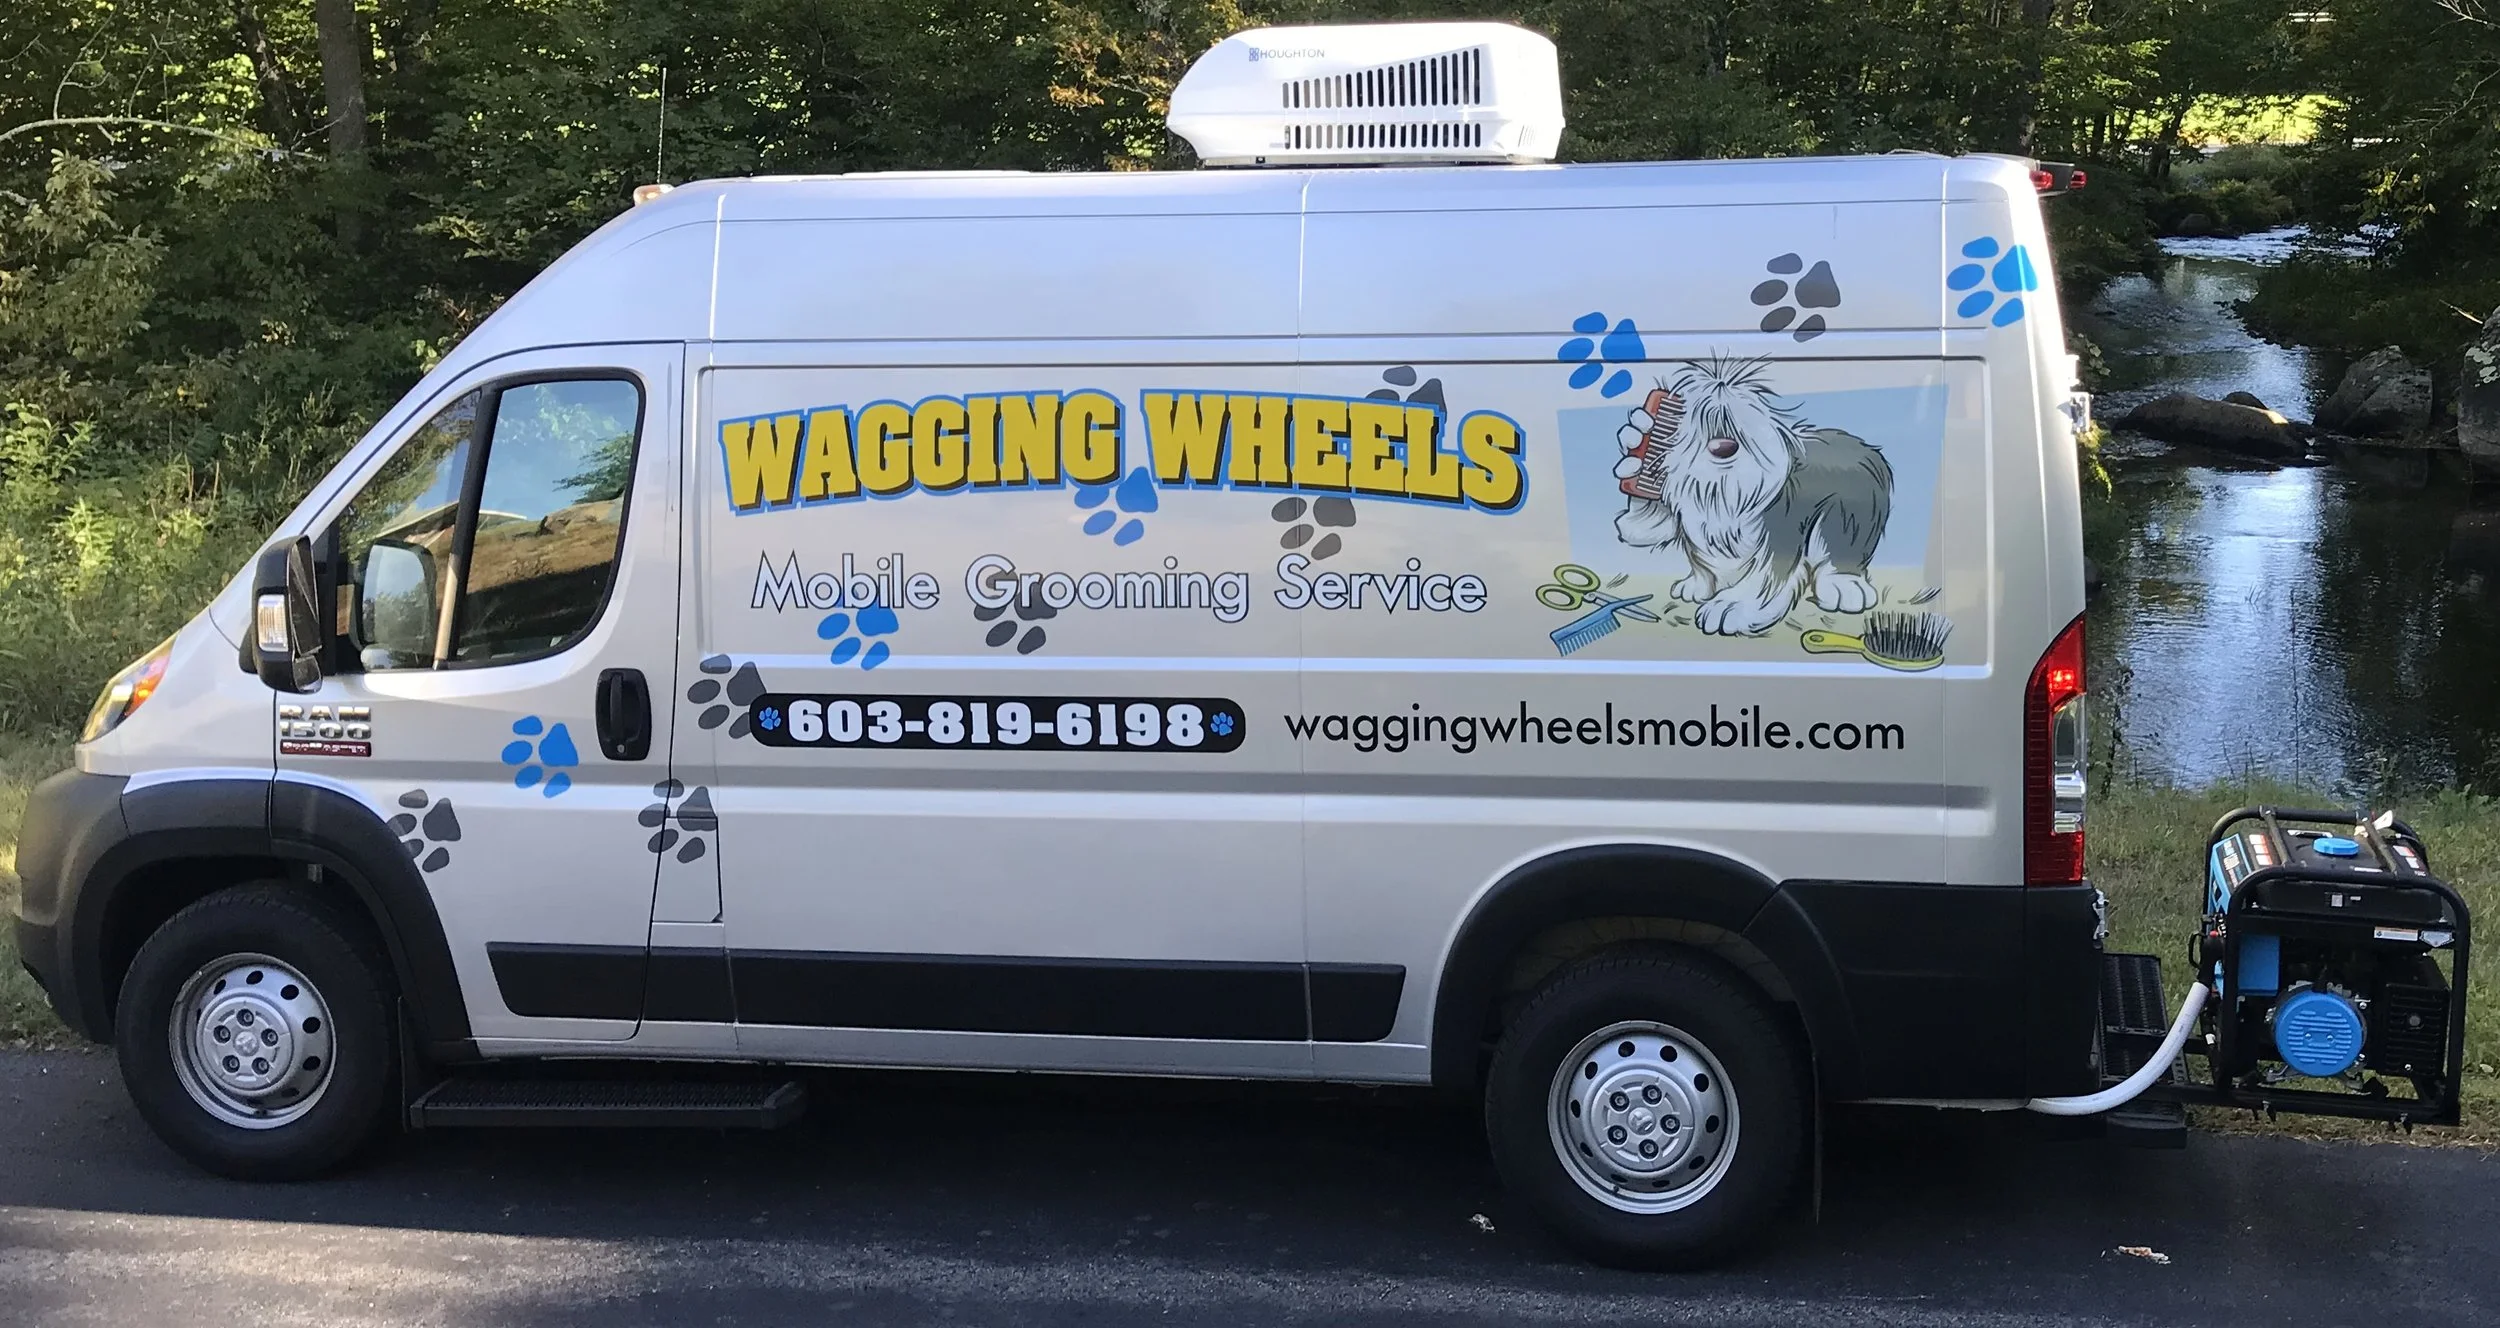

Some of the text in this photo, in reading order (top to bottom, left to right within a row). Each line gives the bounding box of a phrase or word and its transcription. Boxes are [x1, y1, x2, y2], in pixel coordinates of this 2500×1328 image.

[1260, 49, 1325, 58] HOUGHTON
[719, 388, 1530, 515] WAGGING WHEELS
[751, 549, 1488, 624] Mobile Grooming Service
[280, 705, 372, 722] RAM
[280, 722, 372, 739] 1500
[788, 699, 1205, 747] 603-819-6198
[1284, 701, 1905, 754] waggingwheelsmobile.com
